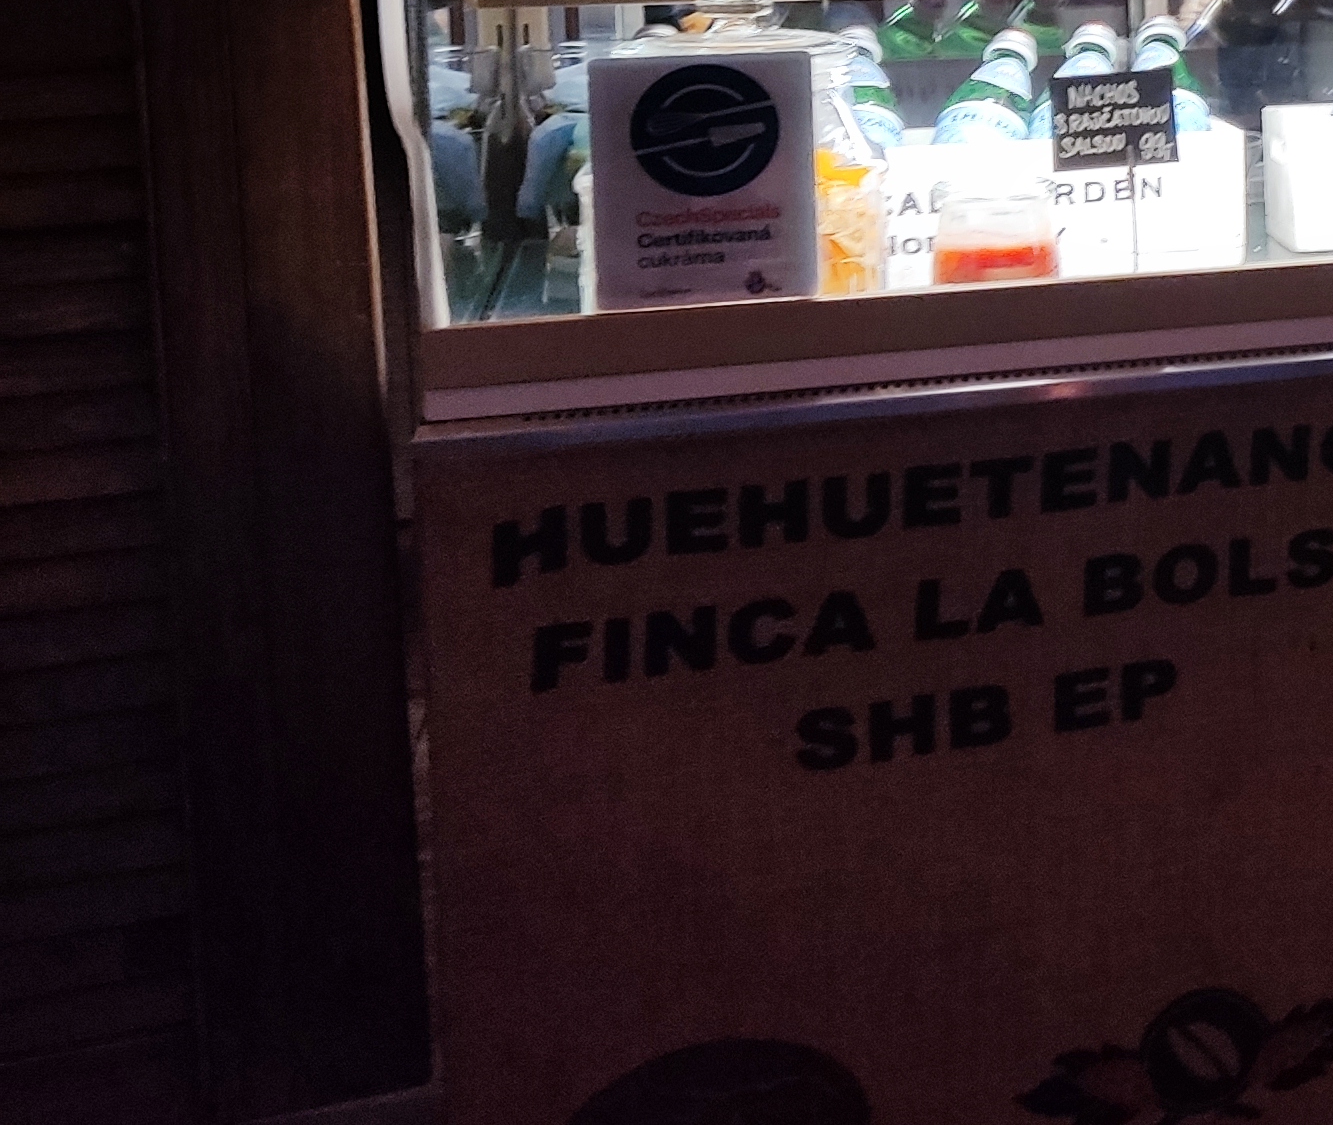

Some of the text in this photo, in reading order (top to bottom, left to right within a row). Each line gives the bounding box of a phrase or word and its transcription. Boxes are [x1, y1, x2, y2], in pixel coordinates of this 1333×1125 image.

[1068, 79, 1140, 110] NACHOS
[1054, 177, 1163, 206] RDEN
[529, 589, 873, 693] FINCA
[914, 565, 1045, 646] LA
[794, 657, 1179, 773] SHB EP
